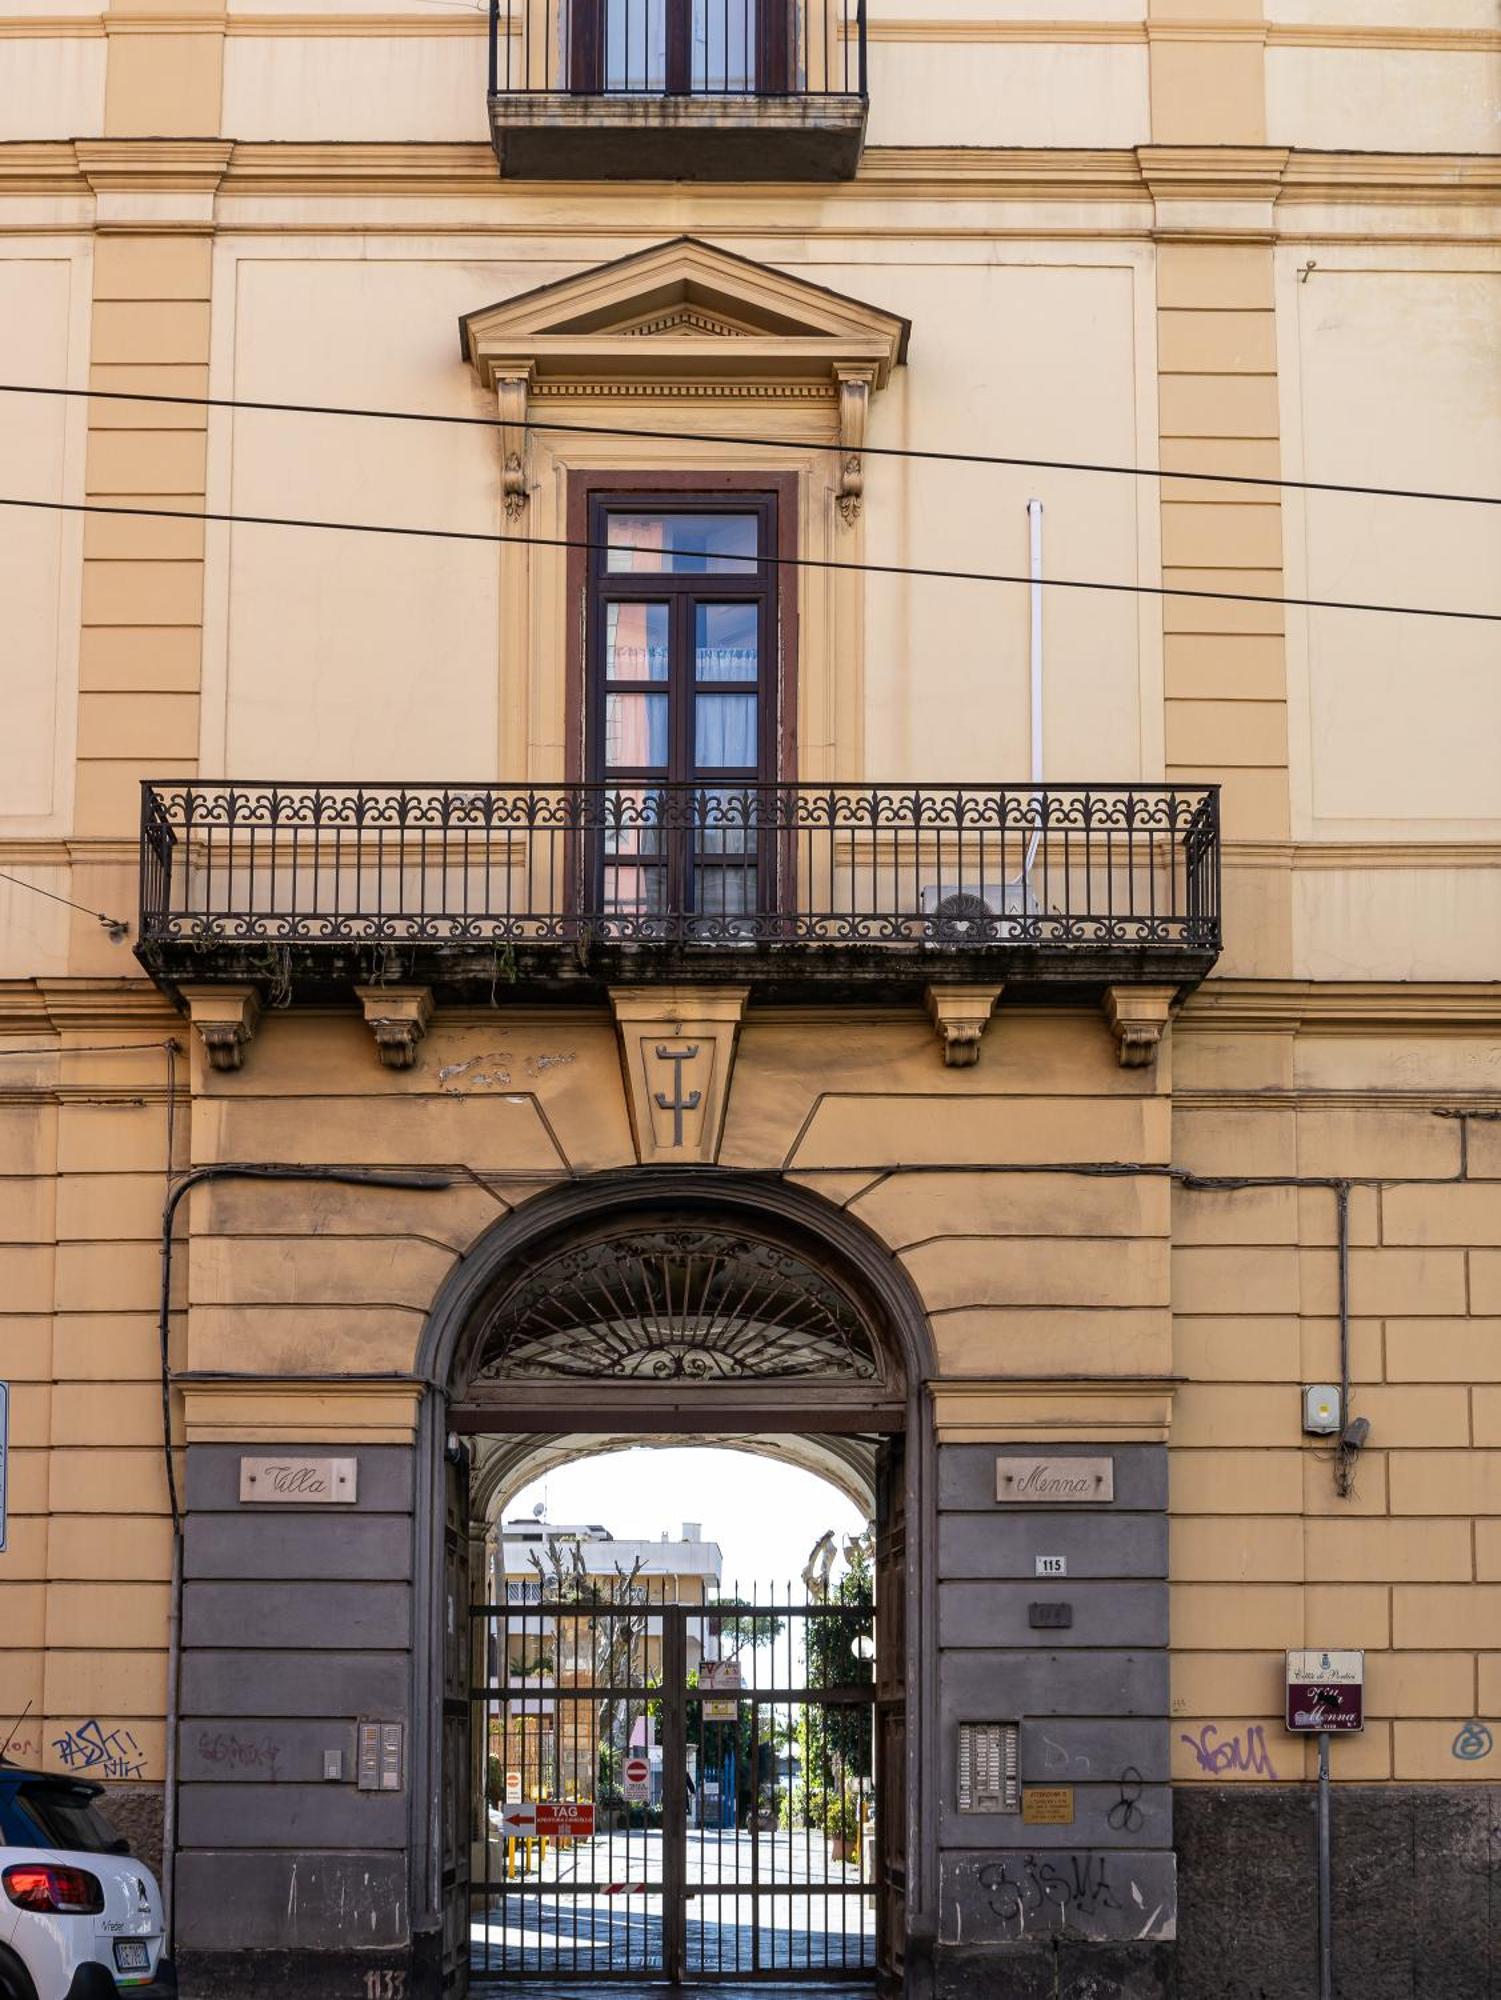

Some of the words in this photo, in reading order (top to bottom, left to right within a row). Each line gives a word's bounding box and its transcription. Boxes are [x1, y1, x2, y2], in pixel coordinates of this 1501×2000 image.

[265, 1466, 328, 1493] Villa
[1017, 1465, 1090, 1492] Menna
[1042, 1559, 1062, 1572] 115
[551, 1806, 578, 1817] TAG
